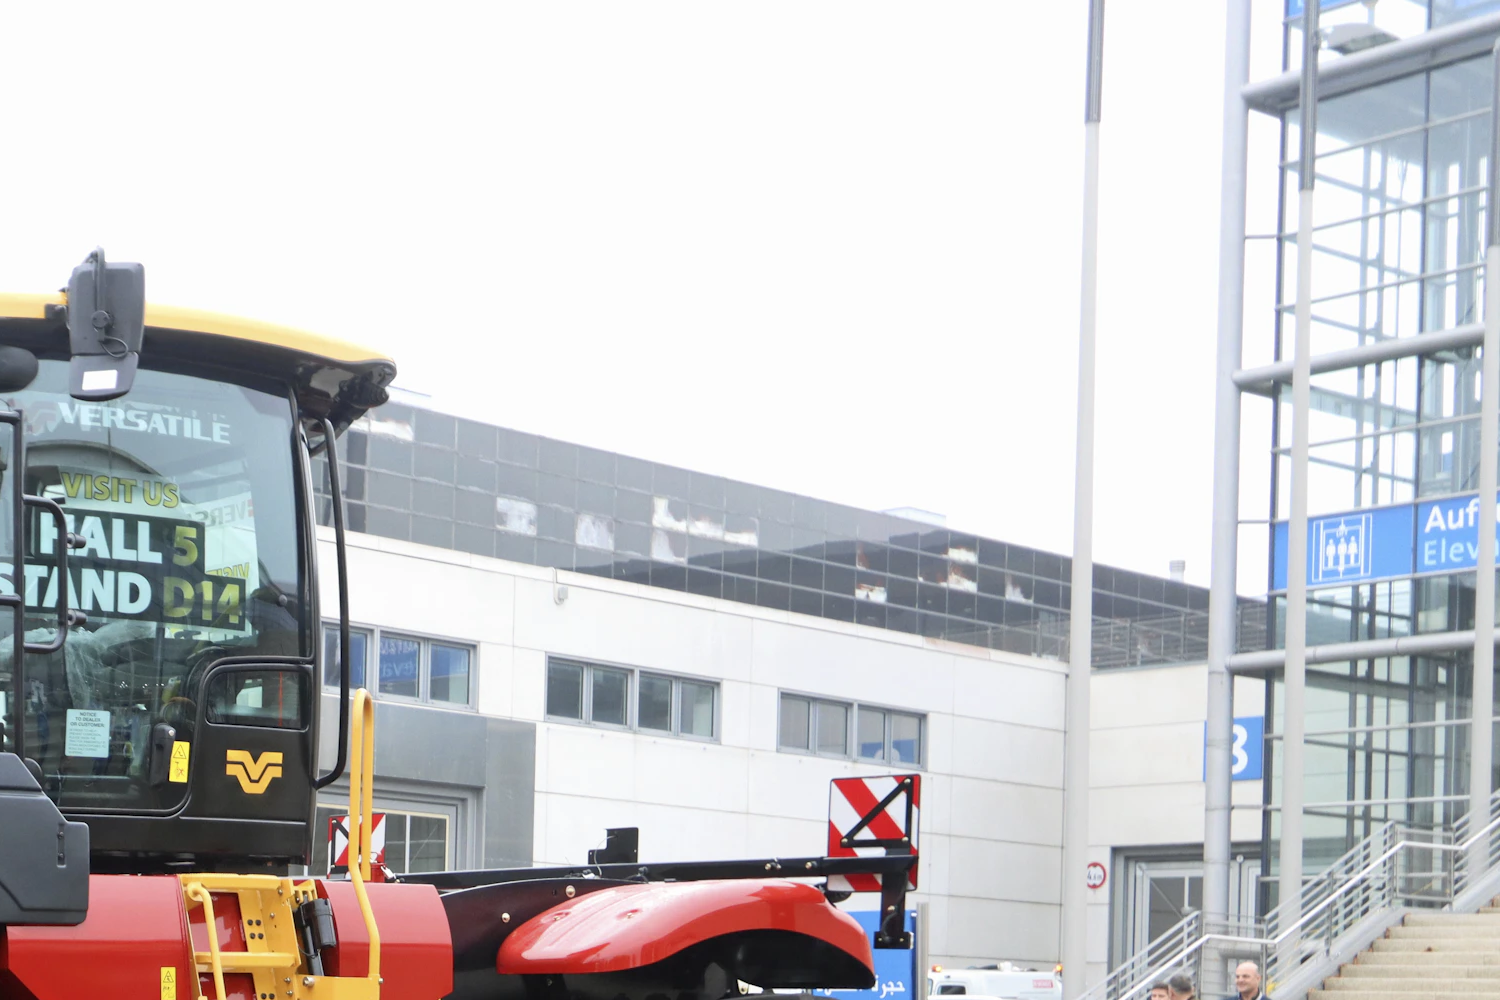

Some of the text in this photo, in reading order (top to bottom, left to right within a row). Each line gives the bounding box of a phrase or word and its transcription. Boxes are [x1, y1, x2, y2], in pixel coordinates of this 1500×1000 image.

[58, 402, 231, 444] VERSATILE
[61, 472, 179, 508] VISIT US
[1424, 498, 1500, 533] Auf
[40, 512, 197, 566] HALL 5
[1424, 536, 1500, 566] Elev
[164, 577, 240, 624] D14
